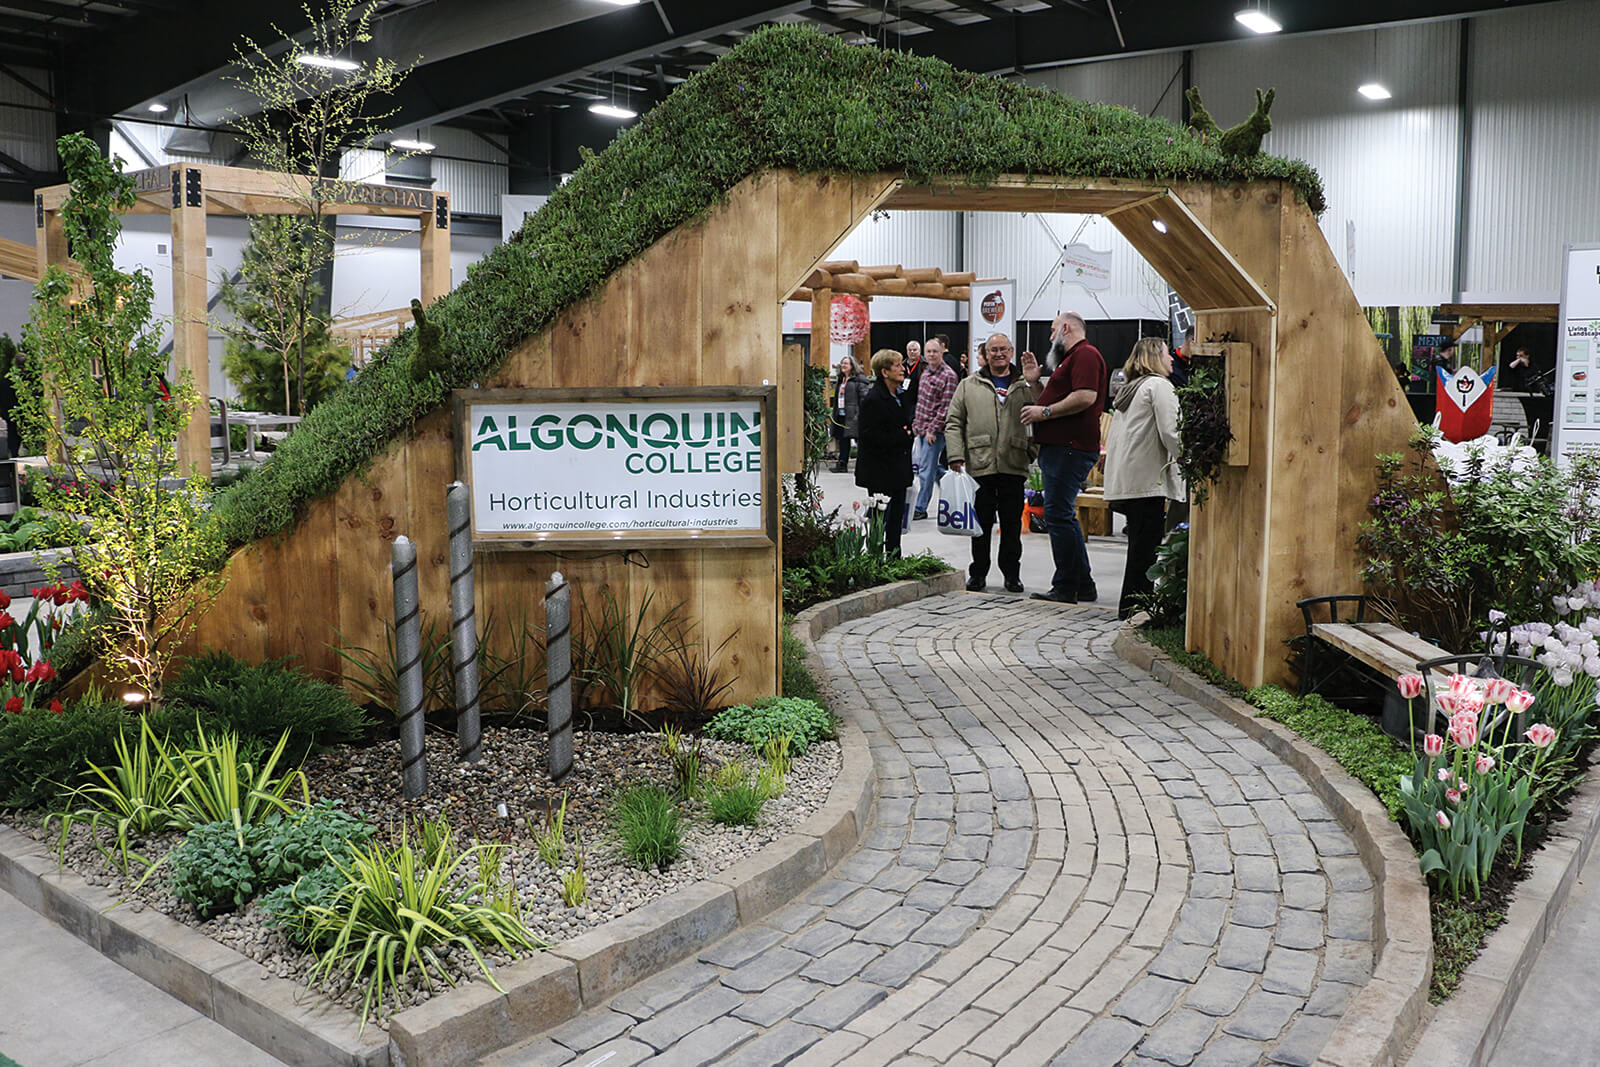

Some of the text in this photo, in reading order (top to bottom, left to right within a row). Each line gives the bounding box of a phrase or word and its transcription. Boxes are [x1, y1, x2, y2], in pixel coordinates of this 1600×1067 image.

[472, 412, 761, 451] ALGONQUIN
[625, 451, 761, 474] COLLEGE
[490, 488, 762, 511] Horticultural Industries
[502, 517, 738, 530] www.algonquincollege.com/horticultural-industries
